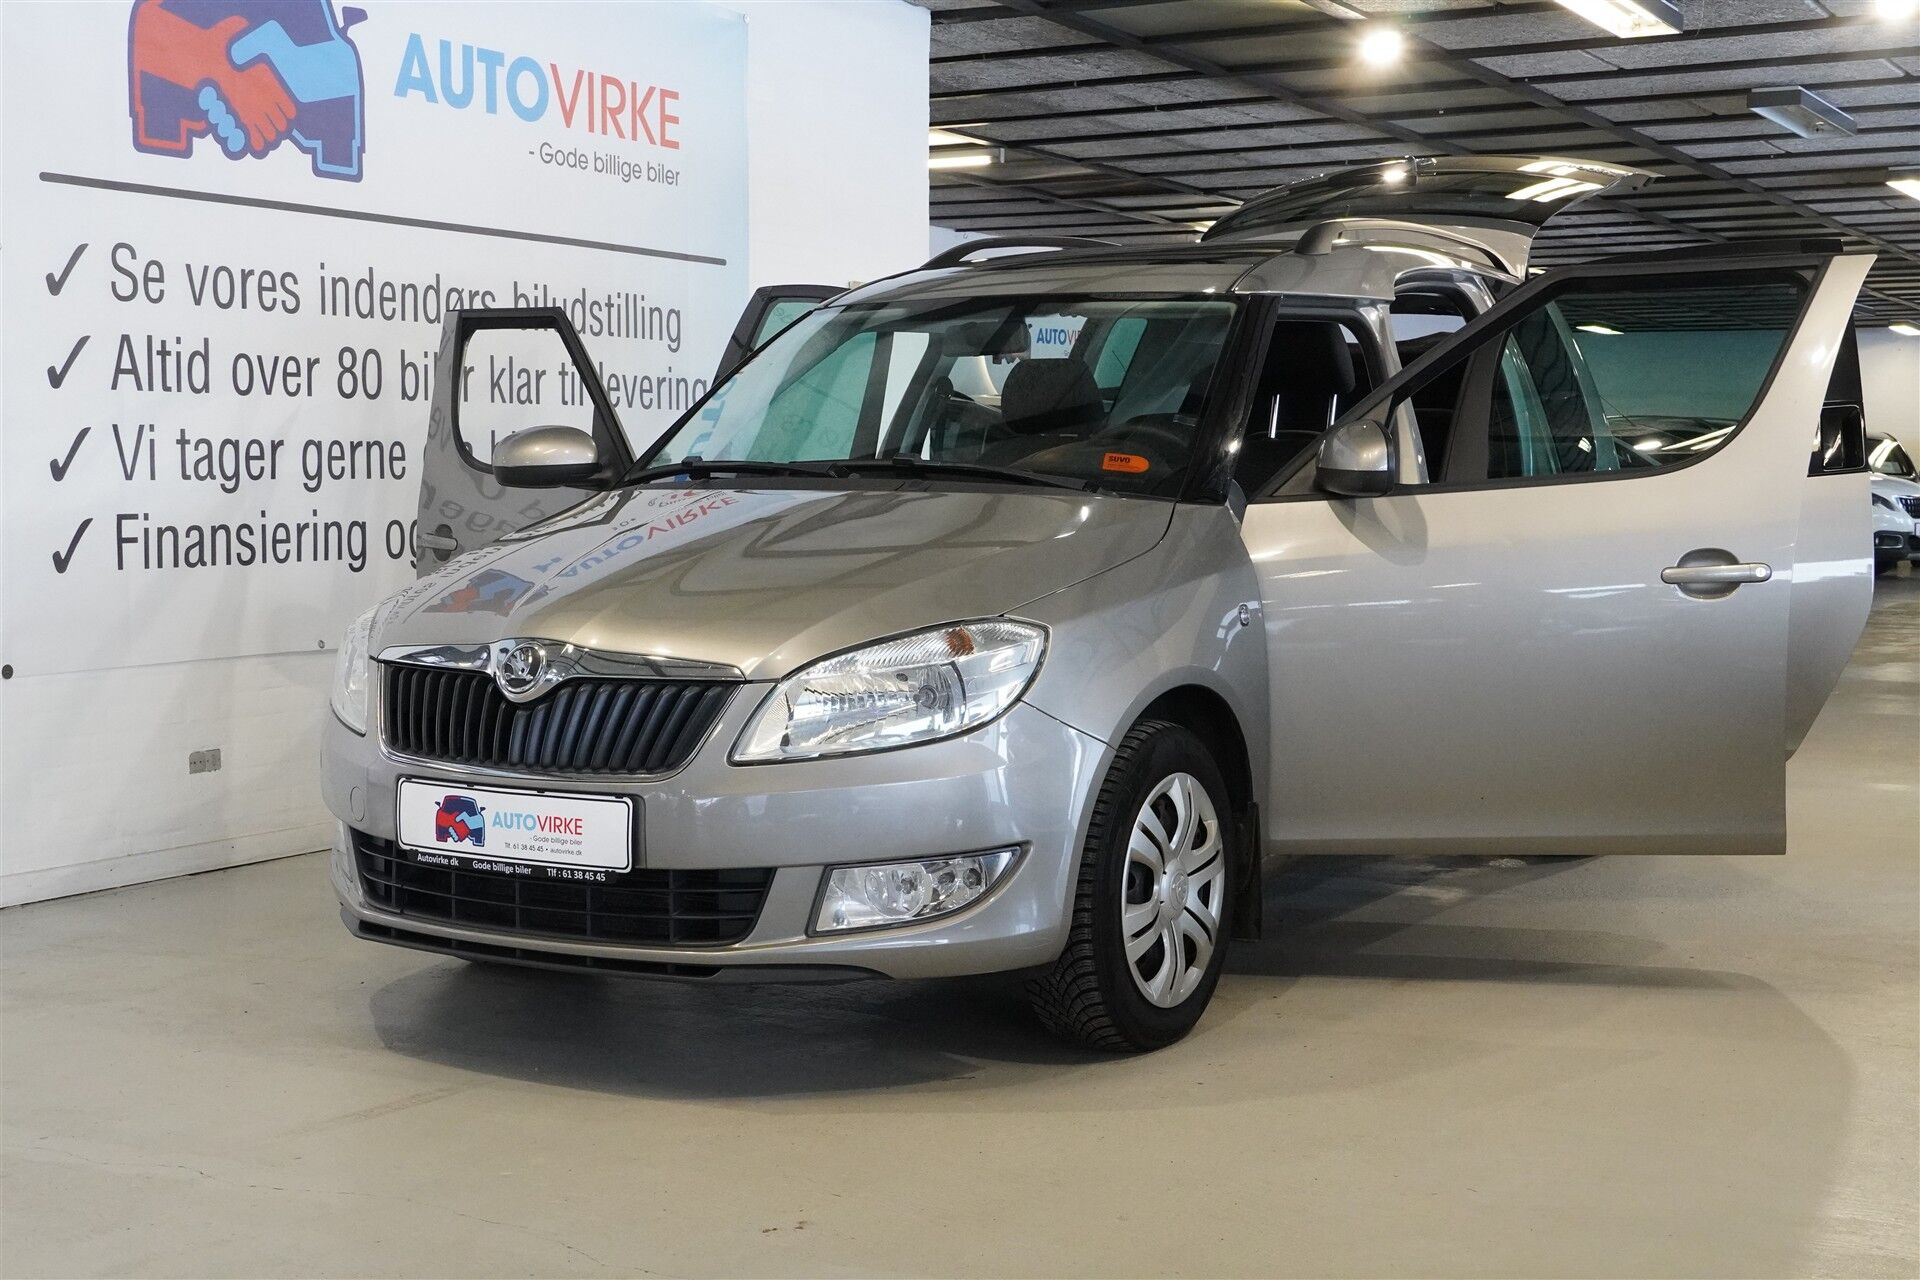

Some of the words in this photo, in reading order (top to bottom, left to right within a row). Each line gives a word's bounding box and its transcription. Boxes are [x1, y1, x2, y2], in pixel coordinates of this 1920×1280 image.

[394, 32, 680, 150] AUTOVIRKE
[539, 141, 588, 171] Gode
[593, 151, 642, 183] billige
[646, 160, 680, 187] biler
[110, 242, 165, 304] Se
[185, 263, 301, 314] vores
[110, 333, 210, 395] Altid
[232, 352, 321, 397] over
[337, 346, 383, 400] 80
[400, 349, 475, 403] bilr
[490, 354, 547, 405] klar
[558, 361, 584, 406] til
[111, 423, 156, 481] Vi
[176, 428, 285, 494] tager
[301, 438, 406, 493] gerne
[116, 508, 367, 573] Finansiering
[492, 811, 583, 836] AUTOVIRKE
[520, 843, 528, 851] 38
[528, 844, 536, 852] 45
[536, 845, 545, 853] 45
[532, 834, 550, 843] Gode
[550, 837, 569, 846] billige
[472, 860, 491, 870] Gode
[492, 862, 514, 875] billige
[515, 864, 532, 875] biler
[562, 869, 572, 879] 61
[573, 870, 583, 880] 38
[584, 872, 595, 881] 45
[595, 873, 606, 882] 45
